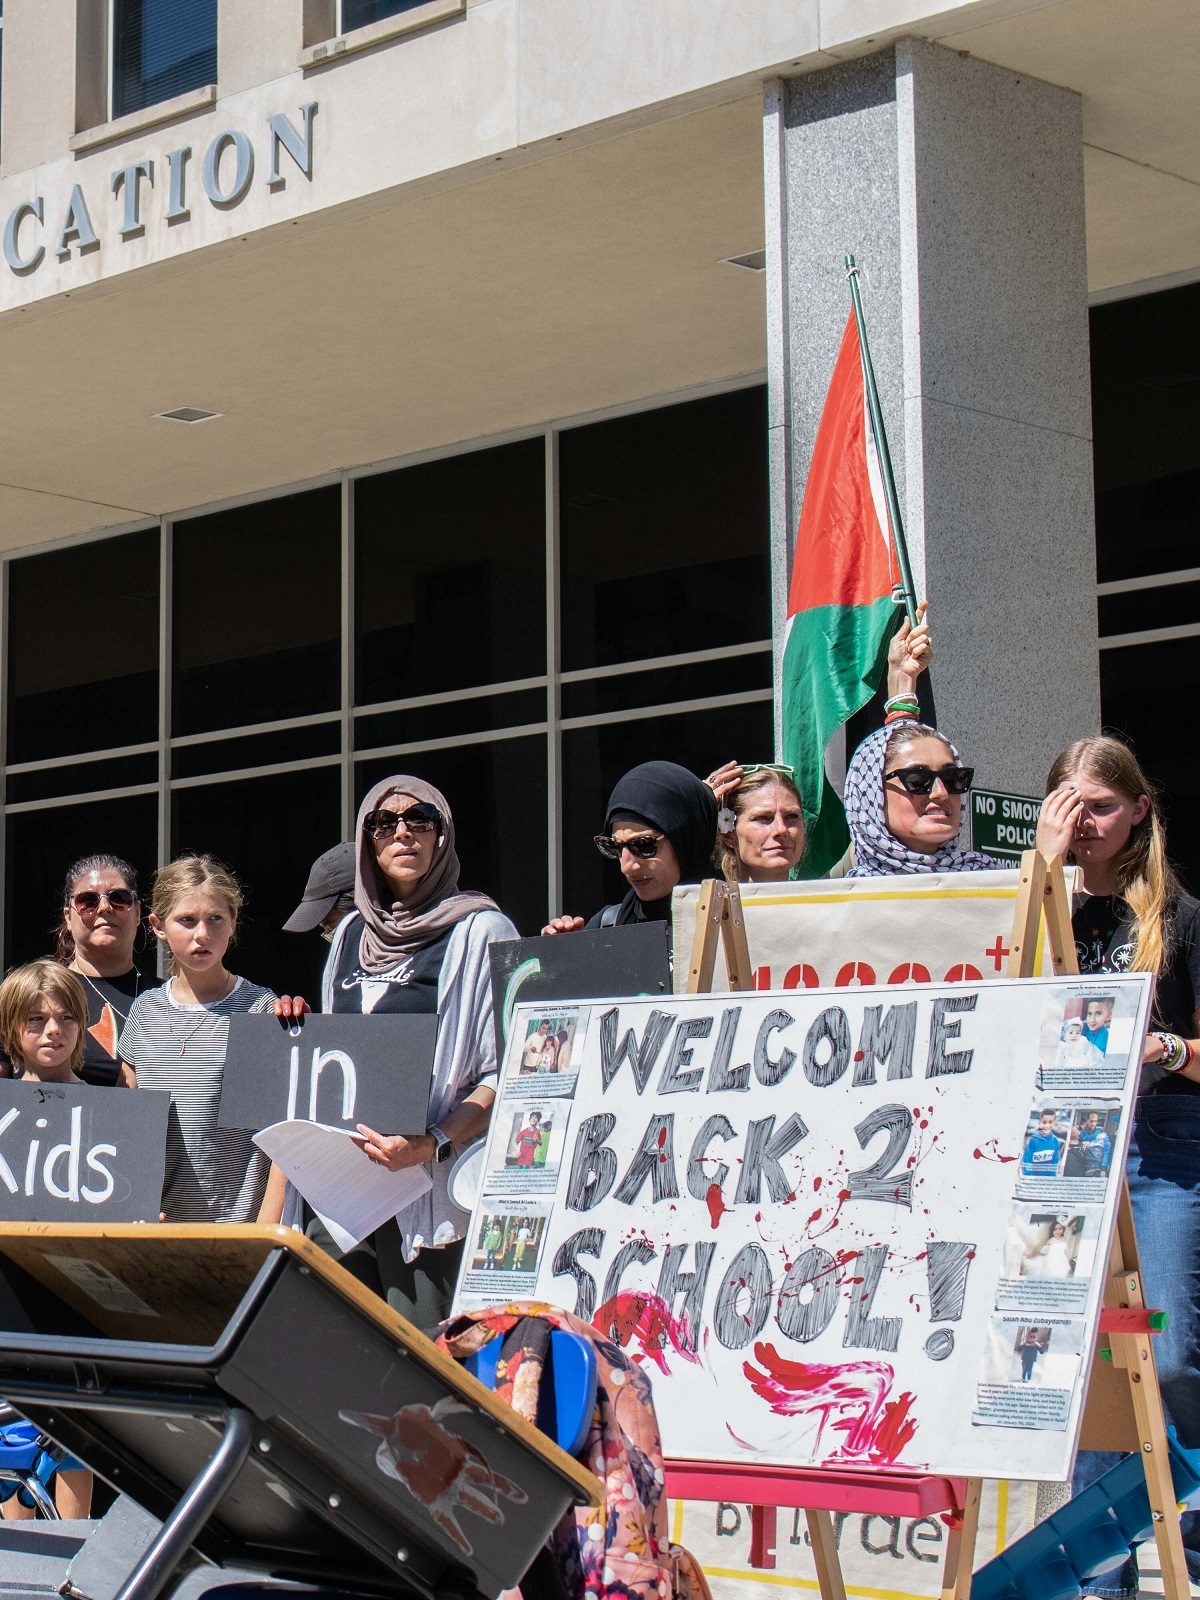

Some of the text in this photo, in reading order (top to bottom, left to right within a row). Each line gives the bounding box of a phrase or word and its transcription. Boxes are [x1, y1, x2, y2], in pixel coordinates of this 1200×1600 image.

[975, 796, 1041, 822] NO SMOK
[997, 824, 1036, 847] POLIC
[286, 1025, 357, 1121] in
[598, 993, 979, 1096] WELCOME
[565, 1103, 914, 1212] BACK 2
[552, 1226, 977, 1361] SCHOOL!
[716, 1501, 753, 1564] b
